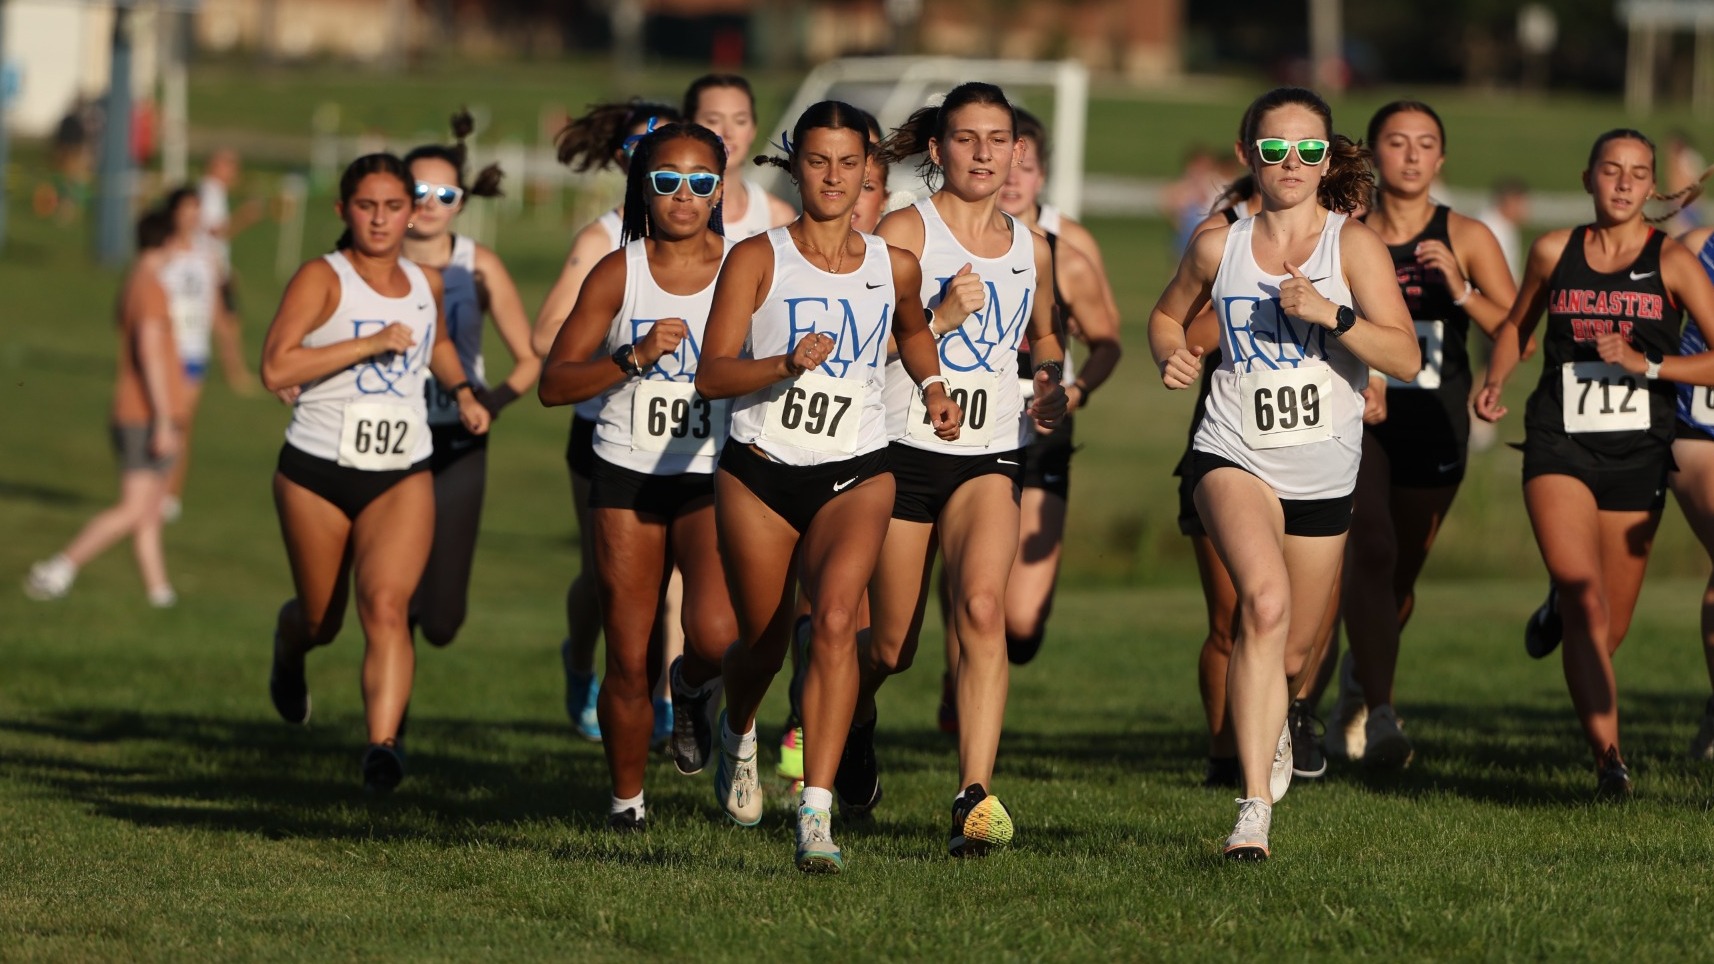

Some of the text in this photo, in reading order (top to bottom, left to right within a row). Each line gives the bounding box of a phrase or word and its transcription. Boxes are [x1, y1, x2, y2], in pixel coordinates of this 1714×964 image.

[1549, 288, 1663, 321] LANCASTER
[1571, 318, 1634, 343] BIBLE
[781, 386, 852, 438] 697
[922, 387, 988, 430] 00
[1254, 383, 1321, 431] 699
[1576, 374, 1638, 415] 712
[354, 419, 408, 455] 692
[647, 396, 712, 439] 693
